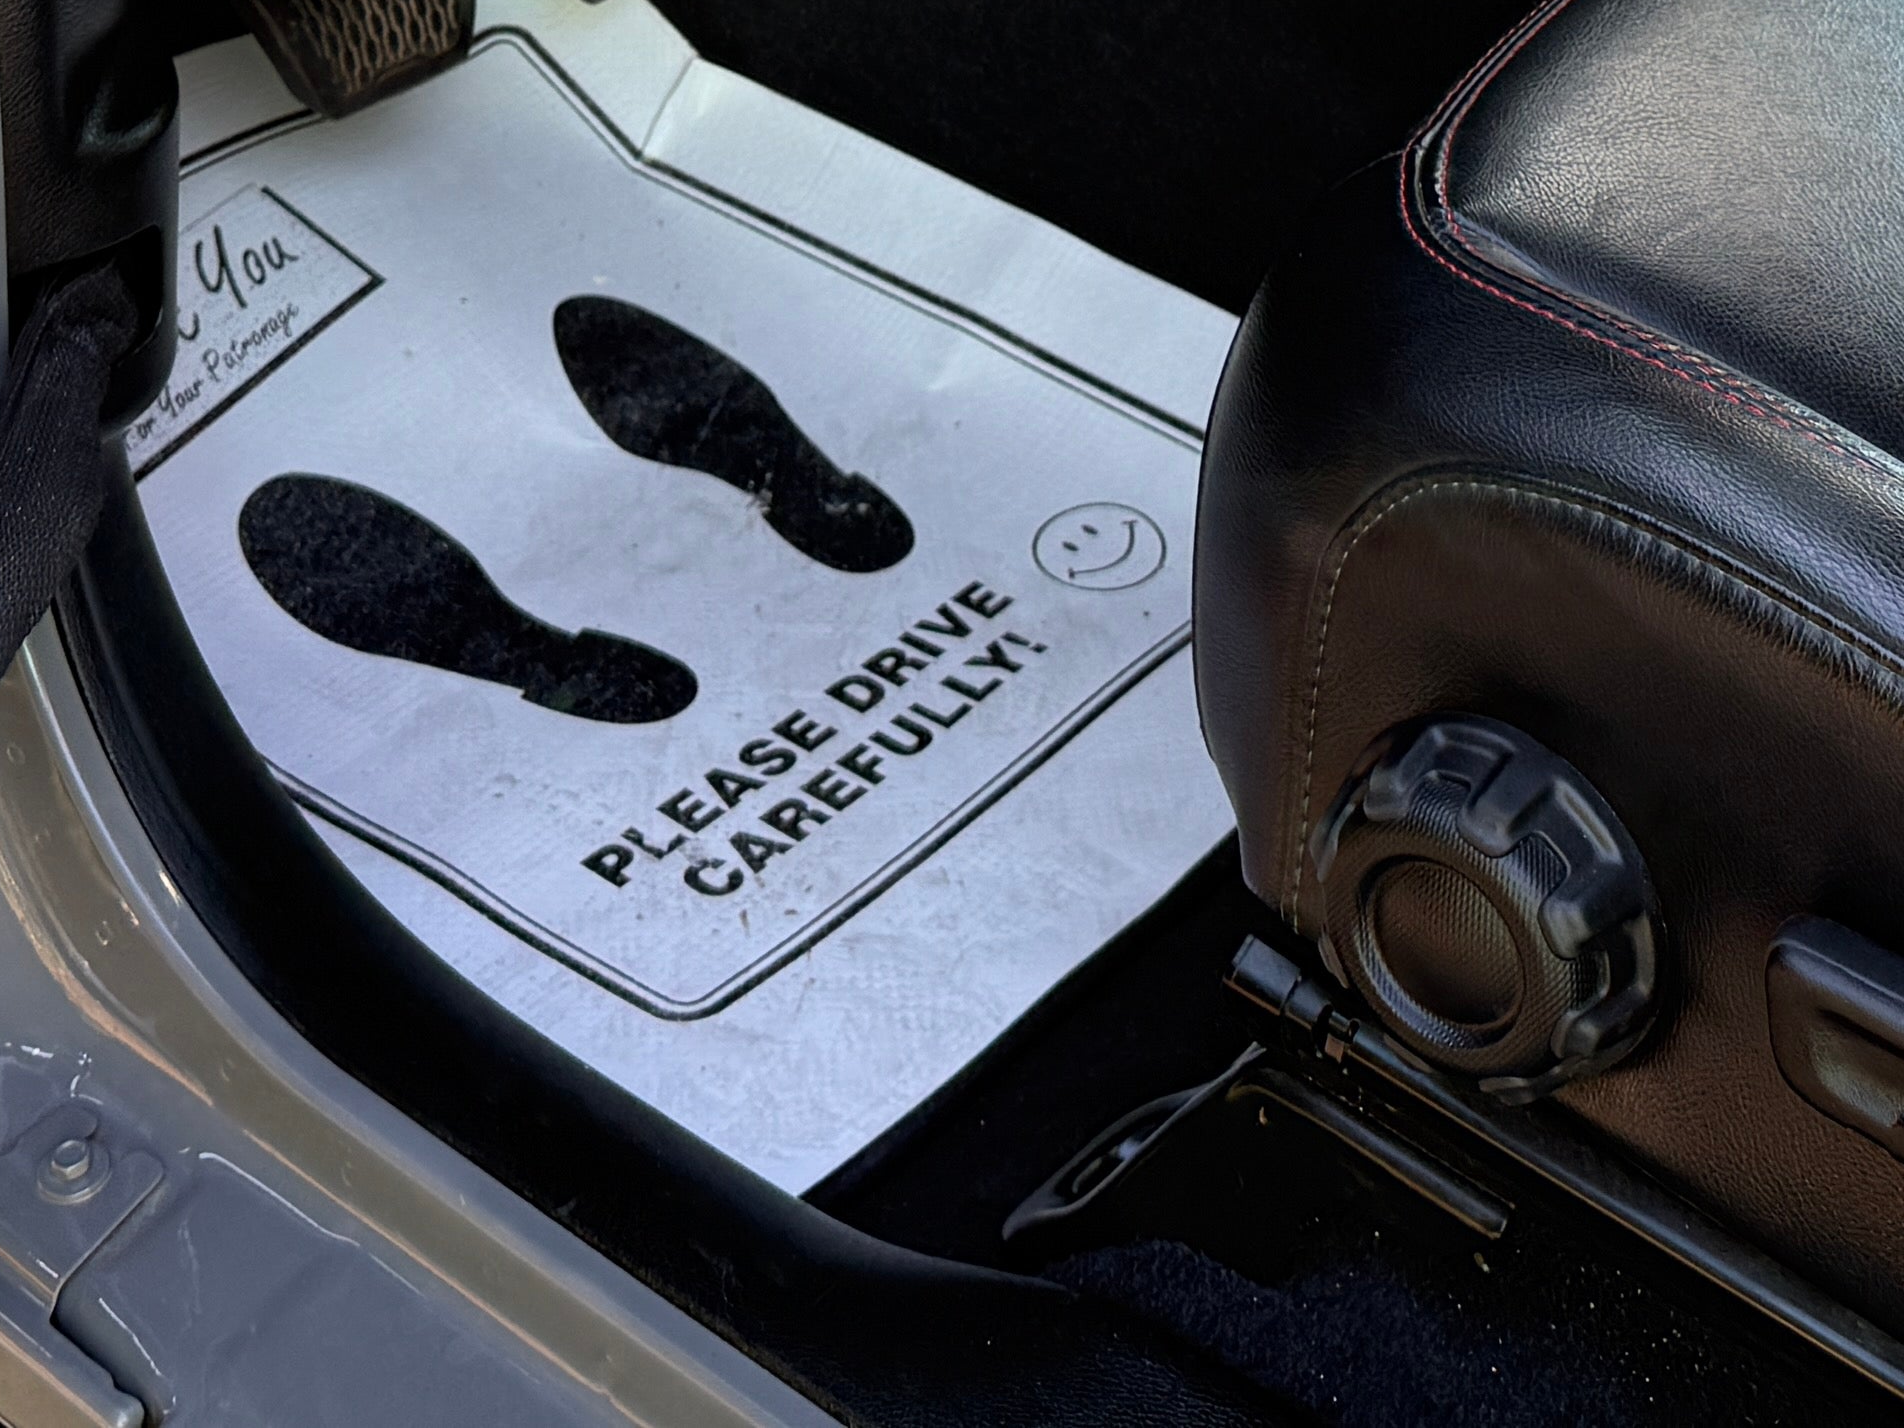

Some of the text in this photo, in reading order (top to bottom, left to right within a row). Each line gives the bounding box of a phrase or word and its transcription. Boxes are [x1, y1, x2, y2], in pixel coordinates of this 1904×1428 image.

[195, 224, 299, 309] You
[201, 301, 300, 383] Patronage
[579, 580, 1016, 888] PLEASE DRIVE
[683, 631, 1050, 896] CAREFULLY!
